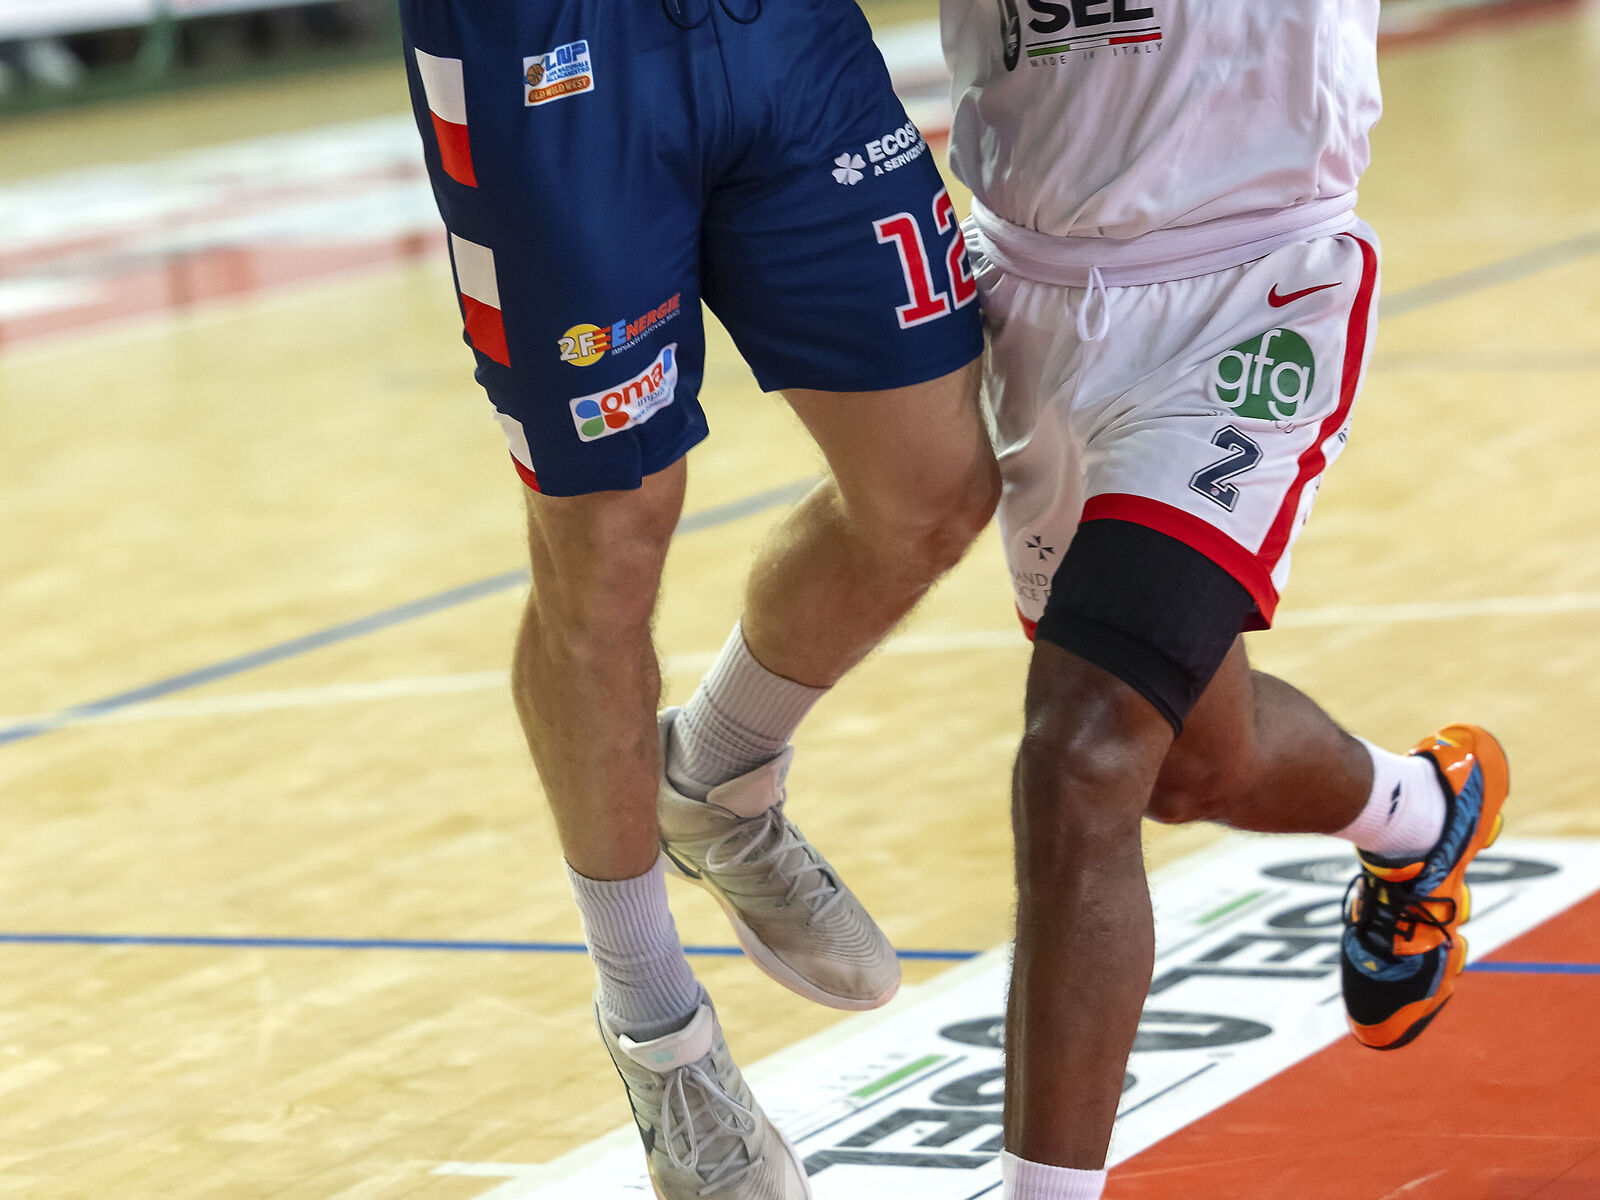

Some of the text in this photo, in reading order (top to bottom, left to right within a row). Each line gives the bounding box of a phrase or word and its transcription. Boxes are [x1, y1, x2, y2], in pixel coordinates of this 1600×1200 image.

[546, 42, 587, 72] LNP
[1113, 42, 1163, 56] ITALY
[874, 164, 885, 177] A
[872, 186, 978, 330] 12
[1209, 329, 1311, 423] gfg
[1190, 424, 1264, 513] 2
